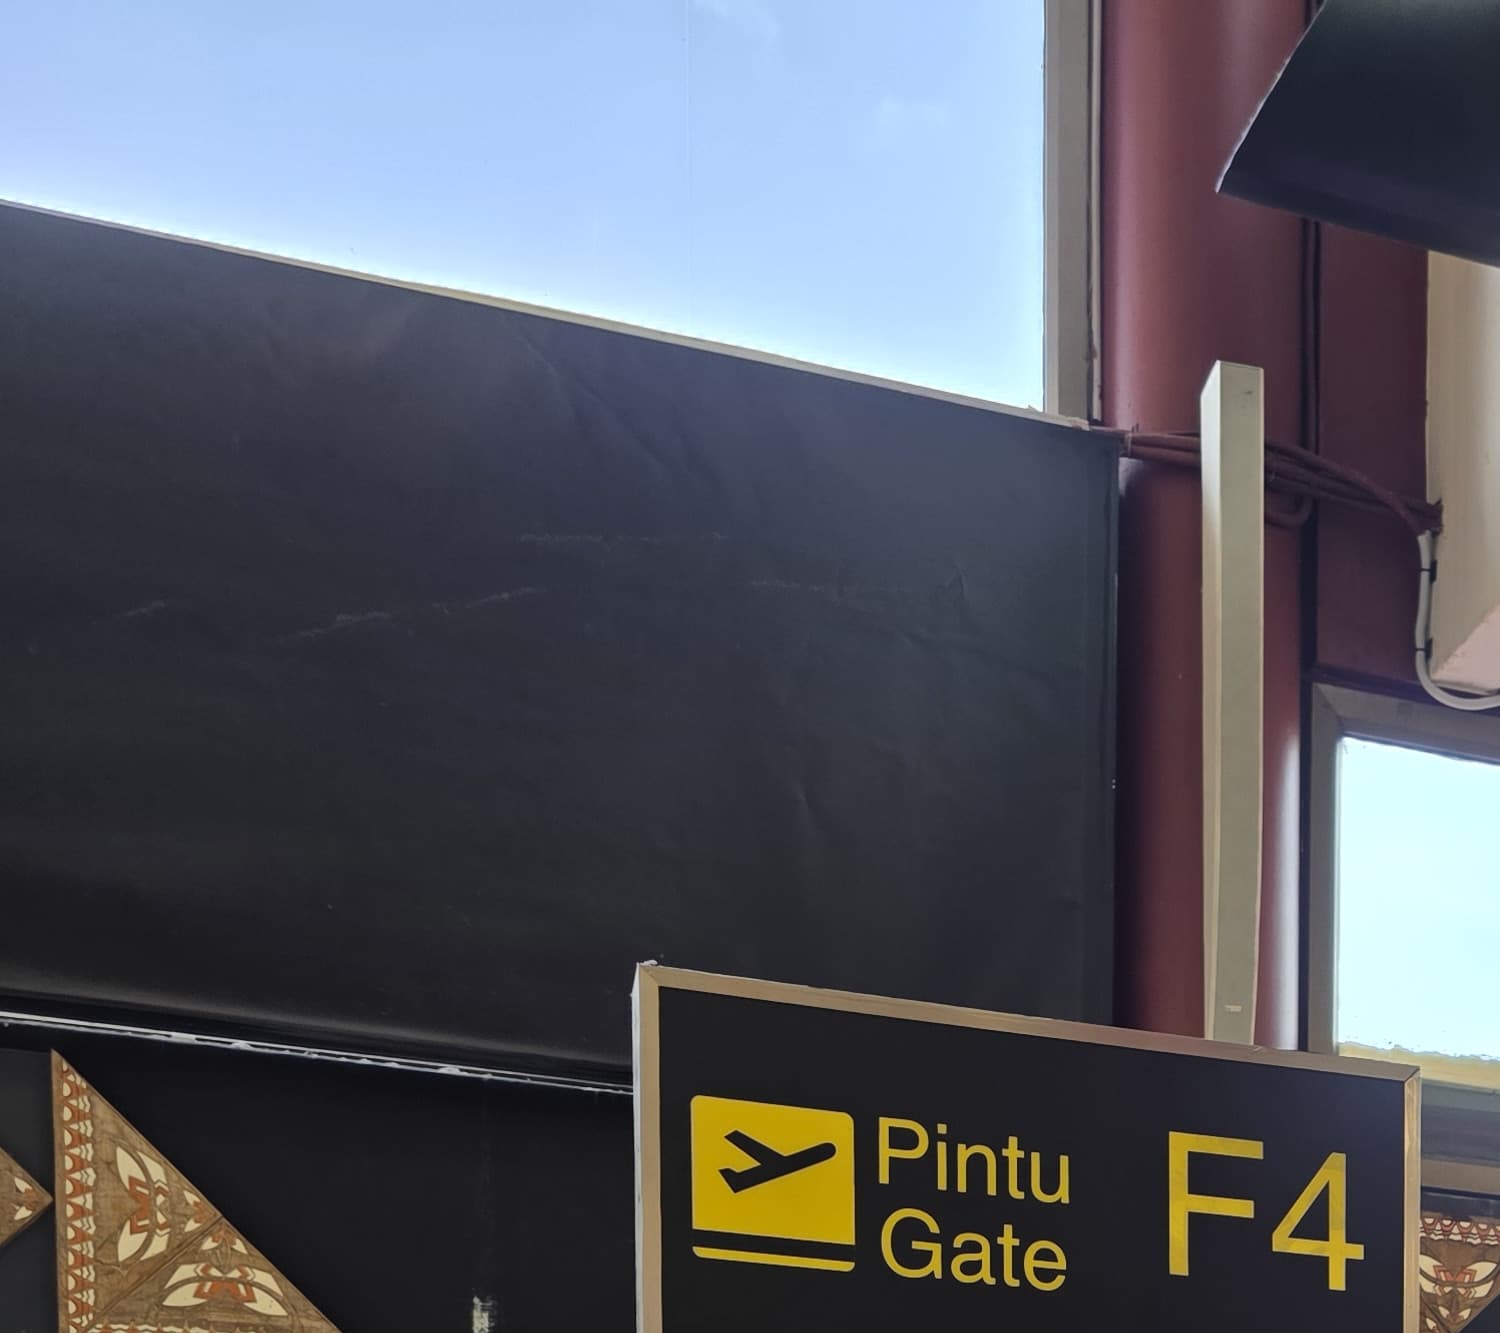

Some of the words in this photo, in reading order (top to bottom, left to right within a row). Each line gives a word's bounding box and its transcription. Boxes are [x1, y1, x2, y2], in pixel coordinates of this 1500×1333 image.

[878, 1116, 1071, 1205] Pintu
[880, 1208, 1067, 1292] Gate
[1168, 1130, 1365, 1292] F4
